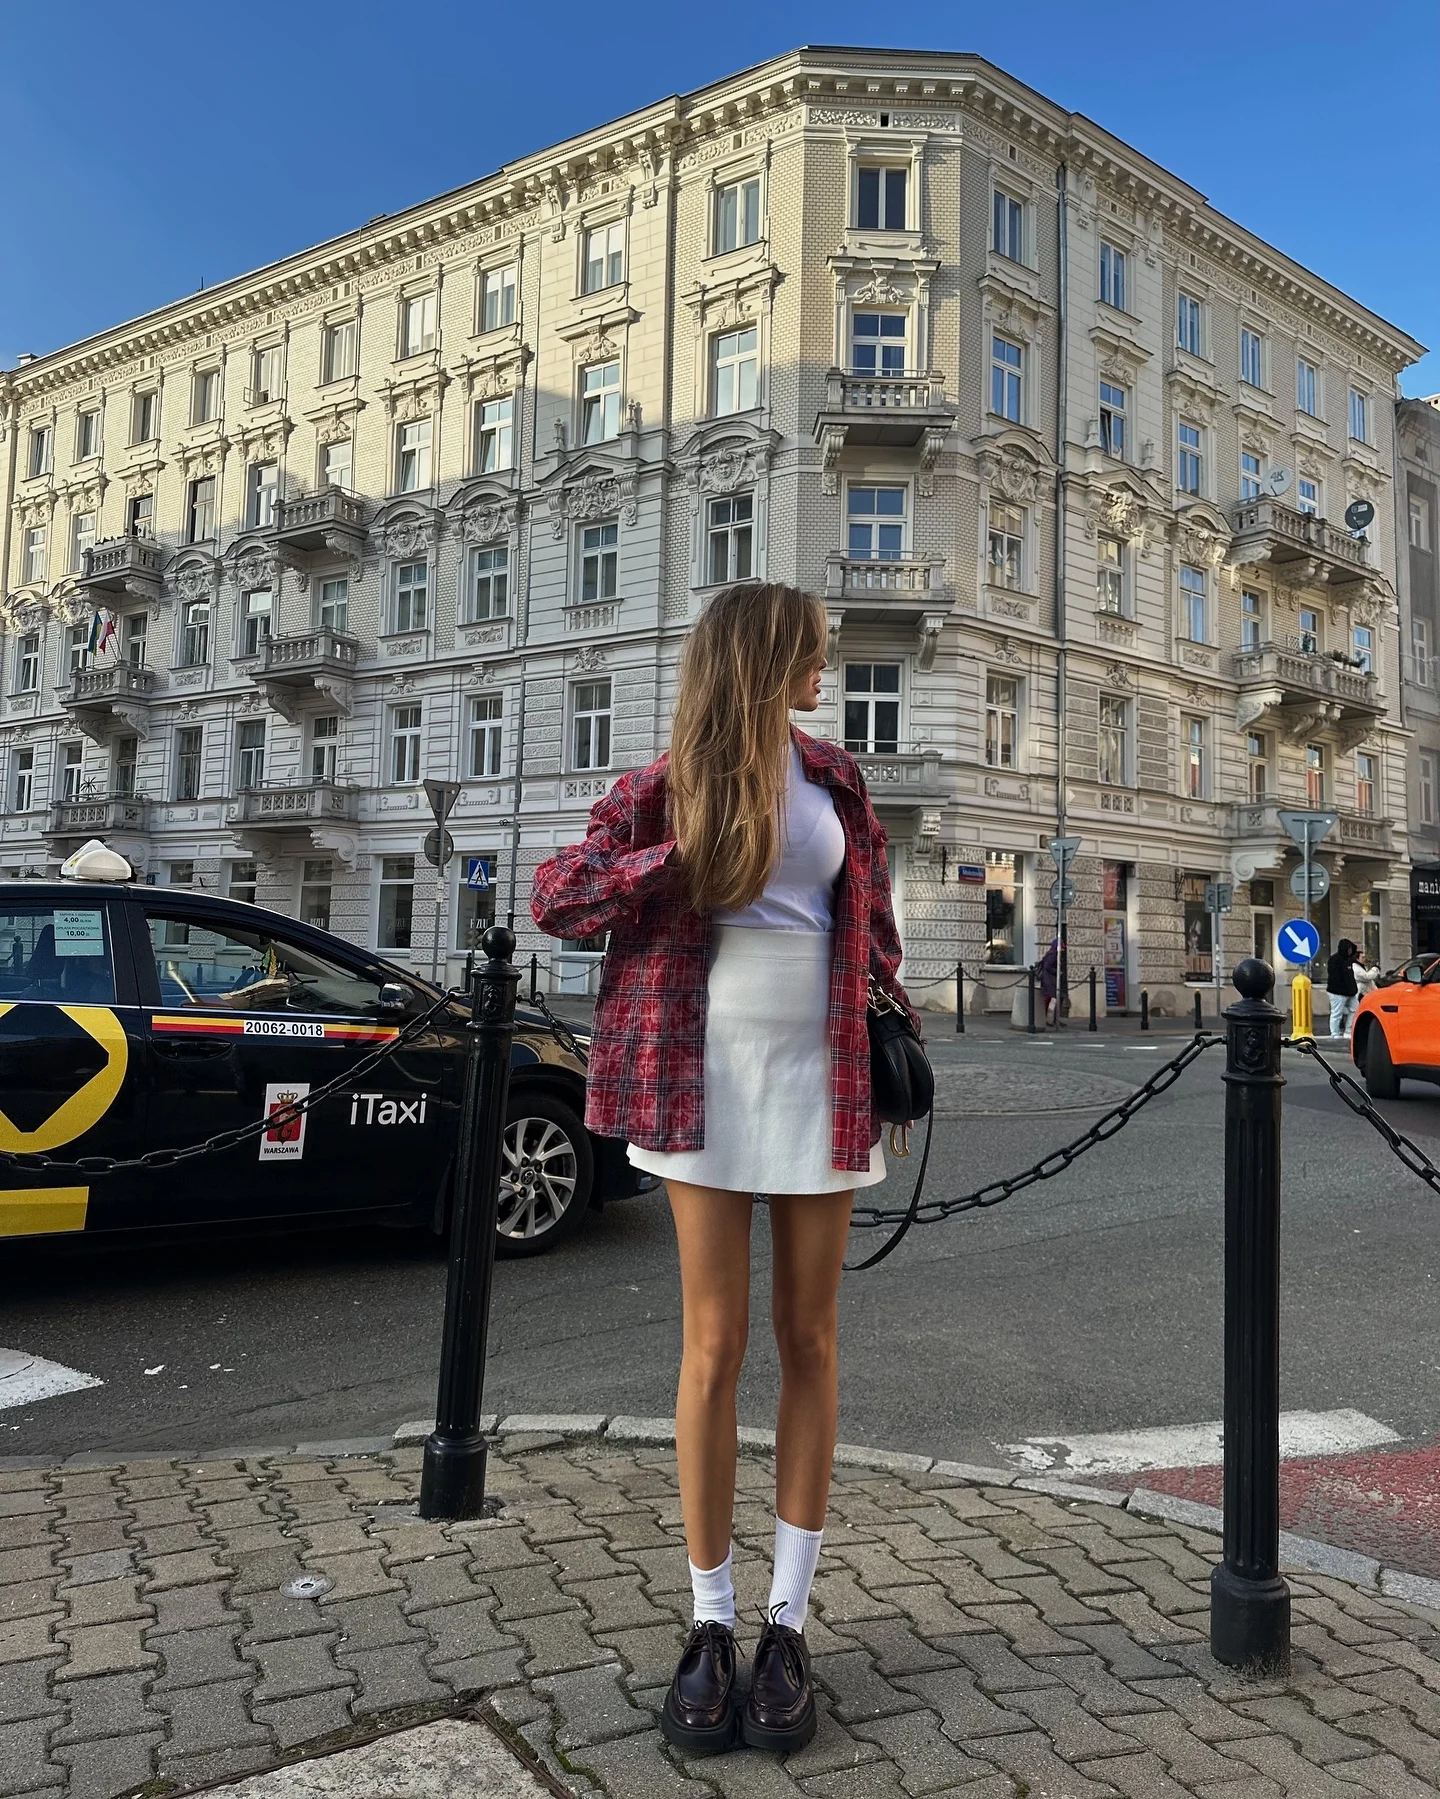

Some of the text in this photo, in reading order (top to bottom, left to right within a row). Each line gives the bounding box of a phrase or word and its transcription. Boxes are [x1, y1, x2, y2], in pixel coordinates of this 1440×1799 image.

[246, 1022, 323, 1036] 20062-0018
[350, 1093, 427, 1125] iTaxi
[263, 1146, 299, 1154] WARSZAWA
